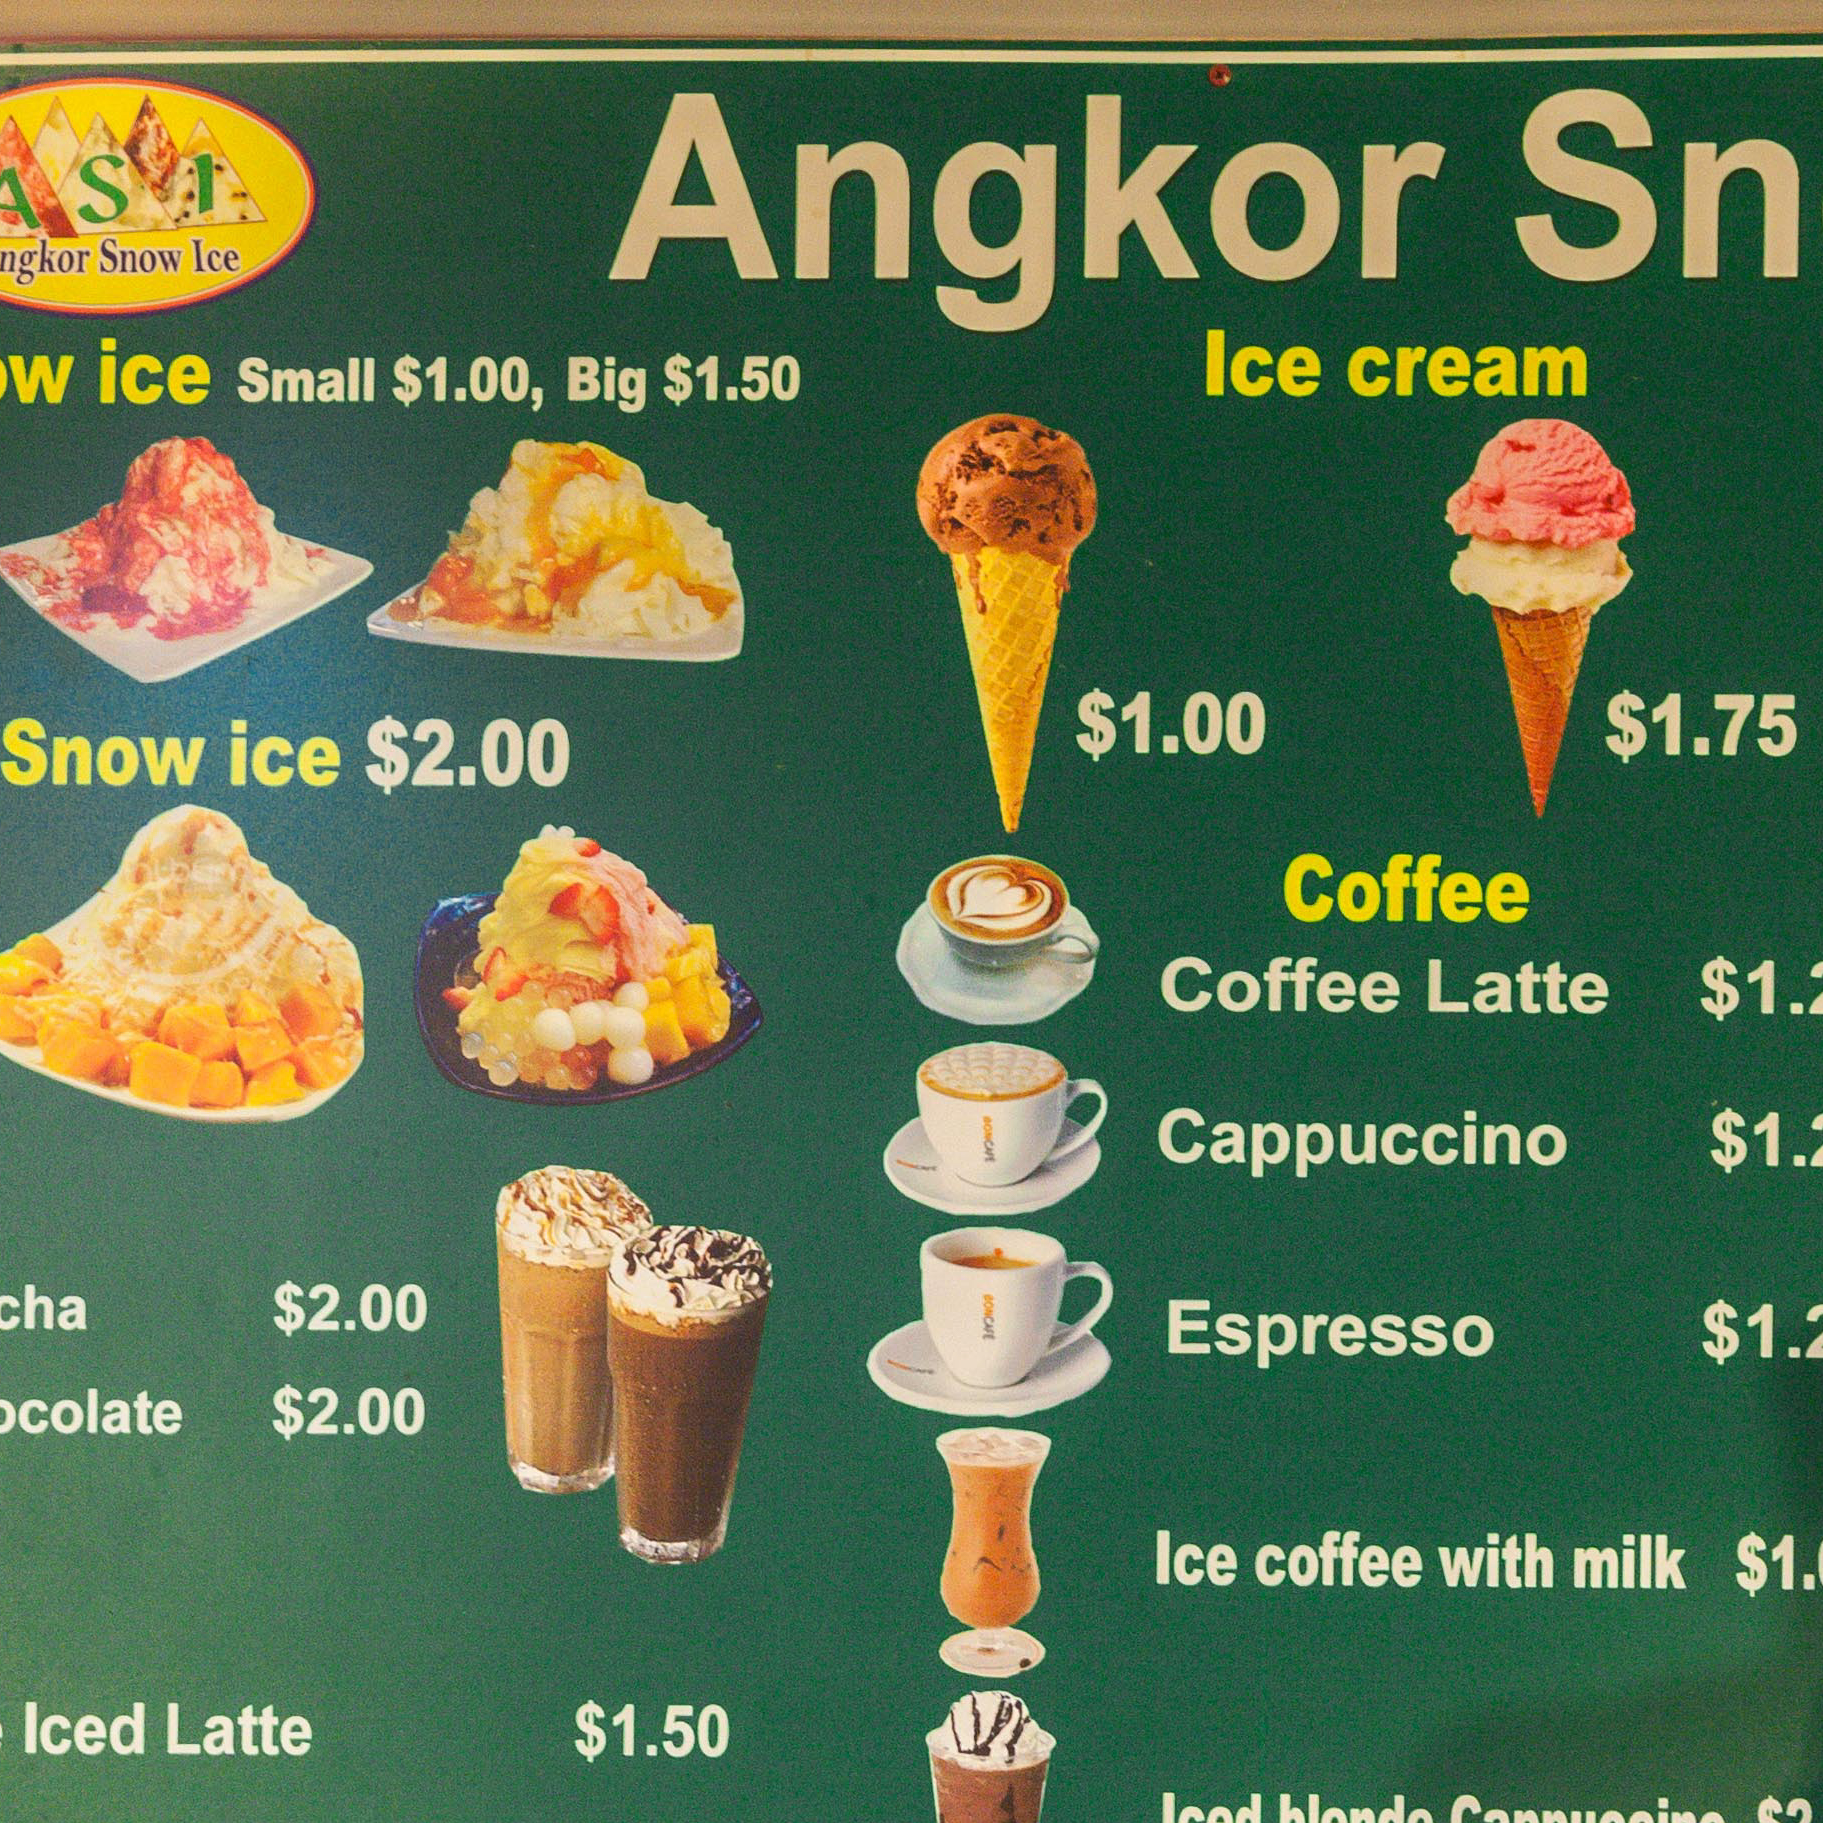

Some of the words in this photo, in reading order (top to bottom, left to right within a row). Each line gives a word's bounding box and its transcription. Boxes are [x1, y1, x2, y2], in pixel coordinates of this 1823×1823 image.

[609, 91, 1445, 333] Angkor
[99, 239, 182, 273] Snow
[191, 240, 240, 273] Ice
[100, 338, 210, 404] ice
[237, 357, 375, 403] Small
[393, 355, 543, 411] $1.00,
[568, 356, 646, 413] Big
[664, 354, 800, 404] $1.50
[1206, 329, 1320, 397] Ice
[1348, 346, 1587, 396] cream
[1, 718, 205, 787] Snow
[230, 719, 340, 787] ice
[366, 716, 569, 794] $2.00
[1077, 689, 1265, 761] $1.00
[1606, 690, 1797, 762] $1.75
[1284, 854, 1529, 923] Coffee
[1161, 956, 1400, 1013] Coffee
[1428, 959, 1608, 1014] Latte
[1158, 1108, 1567, 1178] Cappuccino
[274, 1281, 427, 1336] $2.00
[1168, 1299, 1494, 1369] Espresso
[273, 1384, 425, 1440] $2.00
[1156, 1530, 1237, 1586] Ice
[1255, 1531, 1422, 1587] coffee
[1439, 1533, 1554, 1589] with
[1574, 1534, 1686, 1589] milk
[24, 1701, 145, 1756] Iced
[167, 1702, 312, 1756] Latte
[576, 1701, 729, 1761] $1.50
